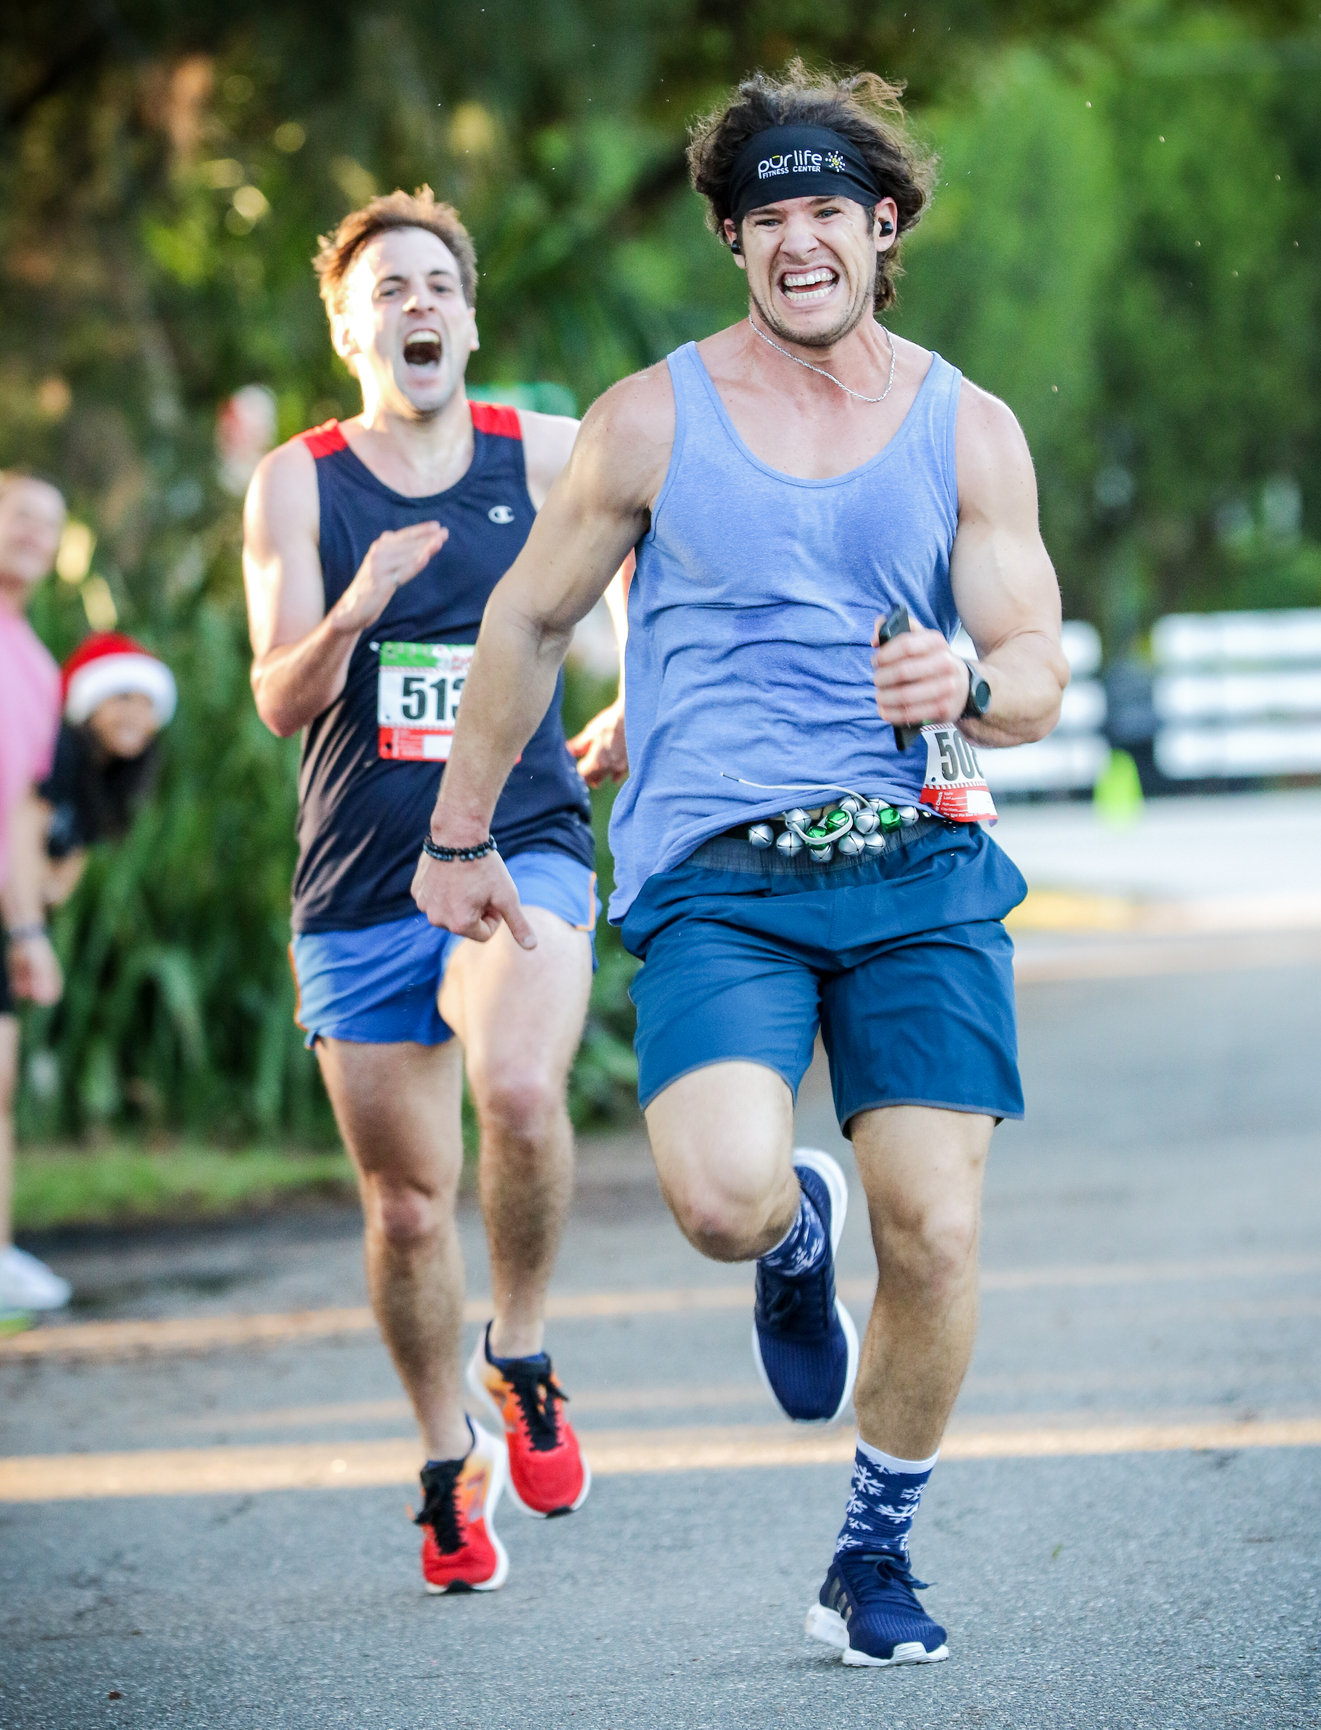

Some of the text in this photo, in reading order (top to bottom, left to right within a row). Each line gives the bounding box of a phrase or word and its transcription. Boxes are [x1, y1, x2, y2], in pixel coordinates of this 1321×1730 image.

[762, 165, 821, 180] FITNESS CENTER
[934, 729, 985, 782] 50
